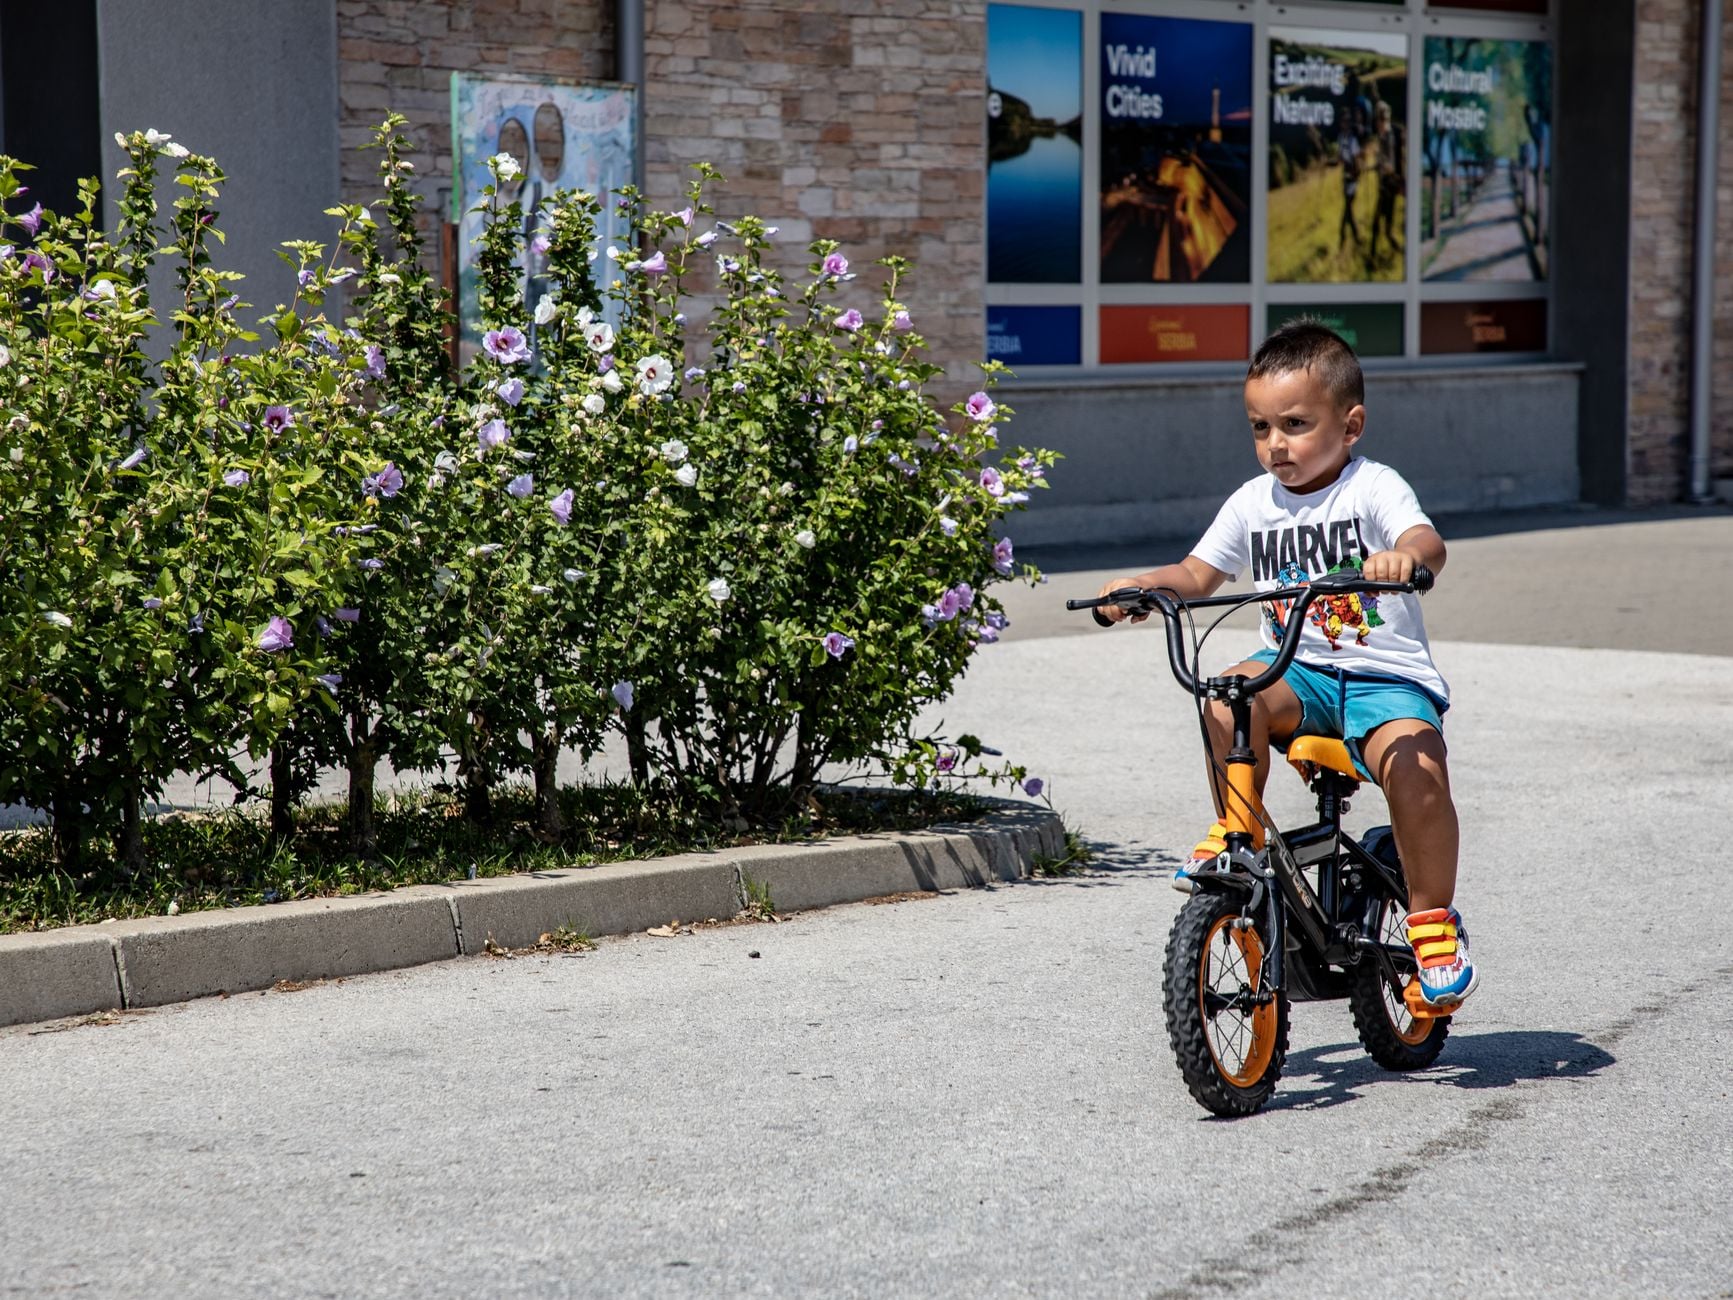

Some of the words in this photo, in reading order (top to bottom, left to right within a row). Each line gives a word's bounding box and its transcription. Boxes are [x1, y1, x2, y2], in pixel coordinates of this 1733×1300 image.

[1106, 44, 1156, 77] Vivid
[1274, 54, 1345, 95] Exciting
[1428, 62, 1493, 93] Cultural
[1106, 84, 1163, 118] Cities
[1274, 94, 1334, 125] Nature
[1427, 100, 1487, 130] Mosaic
